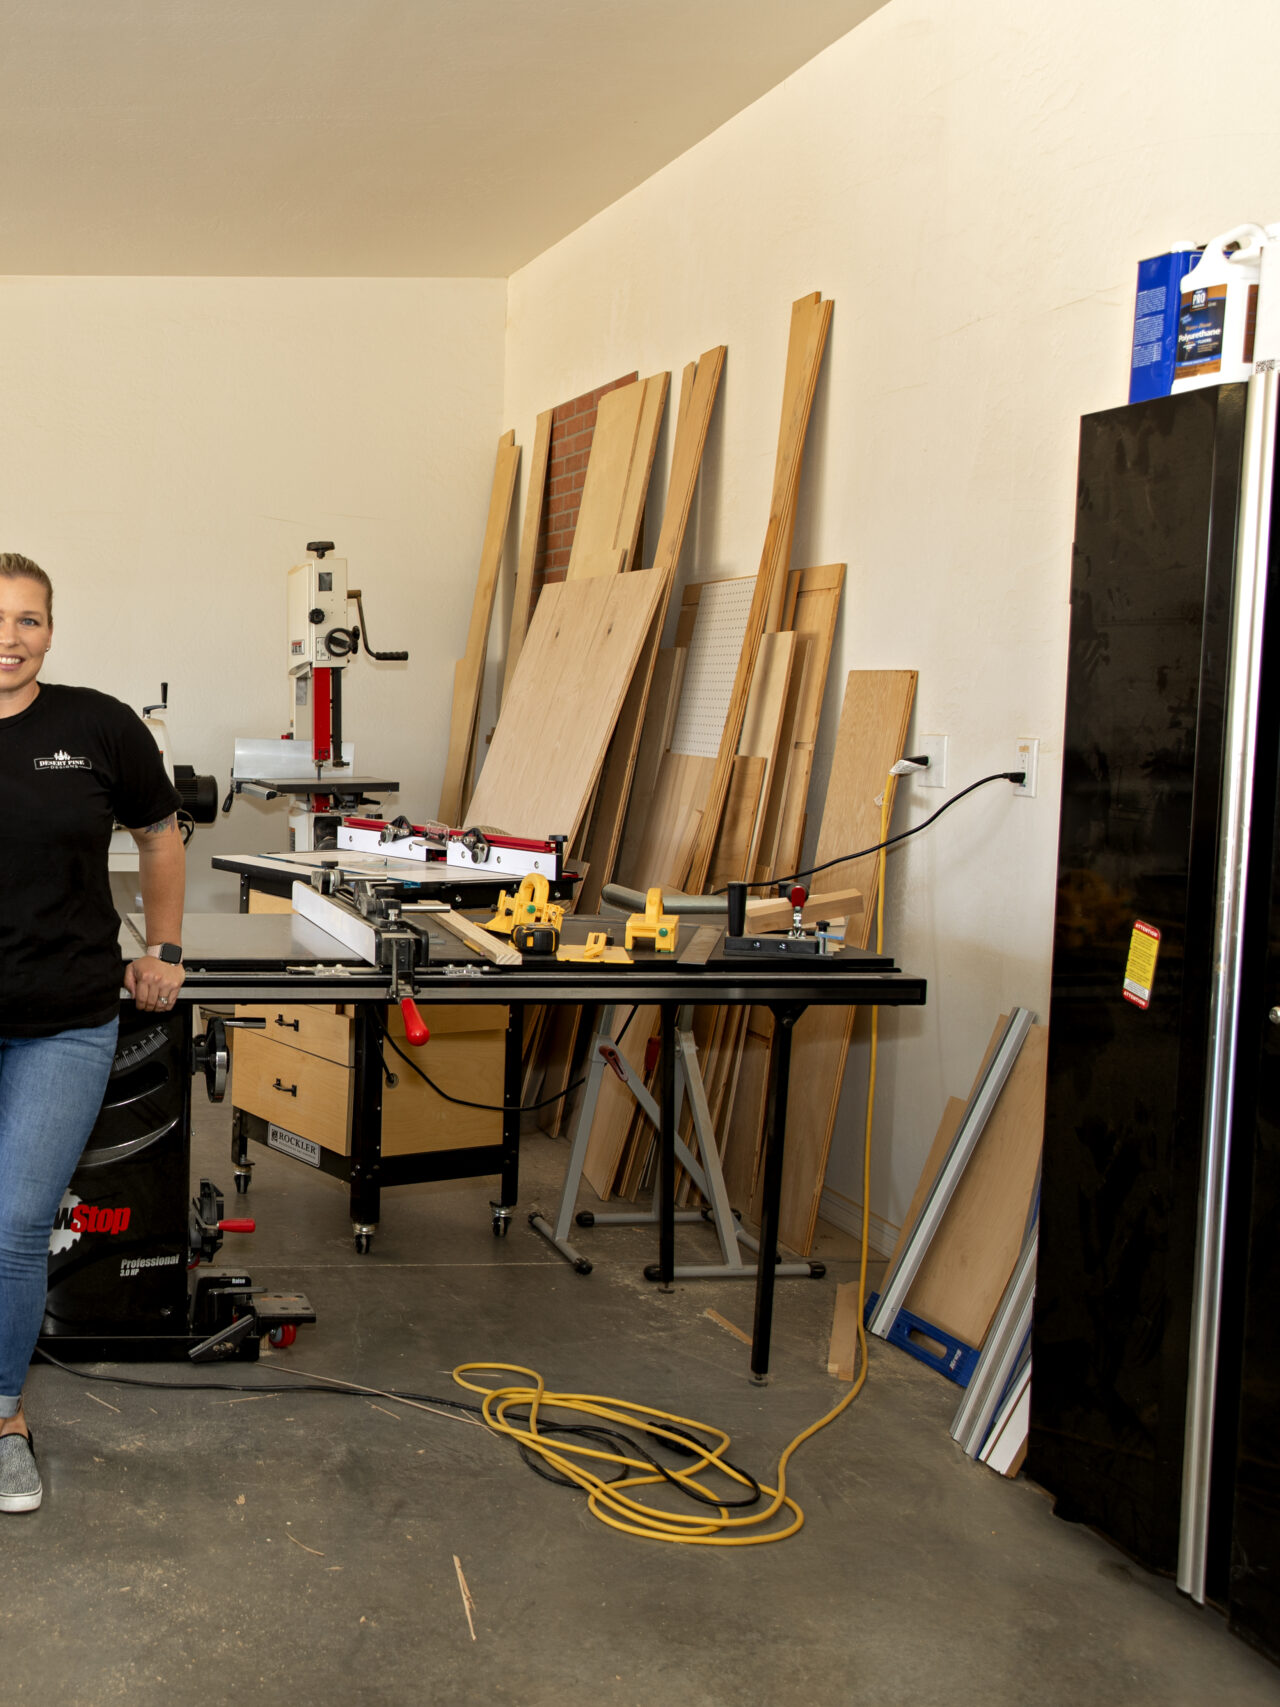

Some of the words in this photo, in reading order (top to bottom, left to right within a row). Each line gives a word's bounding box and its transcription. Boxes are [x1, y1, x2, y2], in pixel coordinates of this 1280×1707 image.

[1192, 293, 1206, 306] PRO
[1178, 329, 1221, 343] Polyurethane
[278, 1132, 317, 1155] ROCKLER
[53, 1204, 131, 1235] wStop
[120, 1254, 180, 1270] Professional
[120, 1269, 130, 1277] 3.0
[130, 1268, 140, 1276] HP
